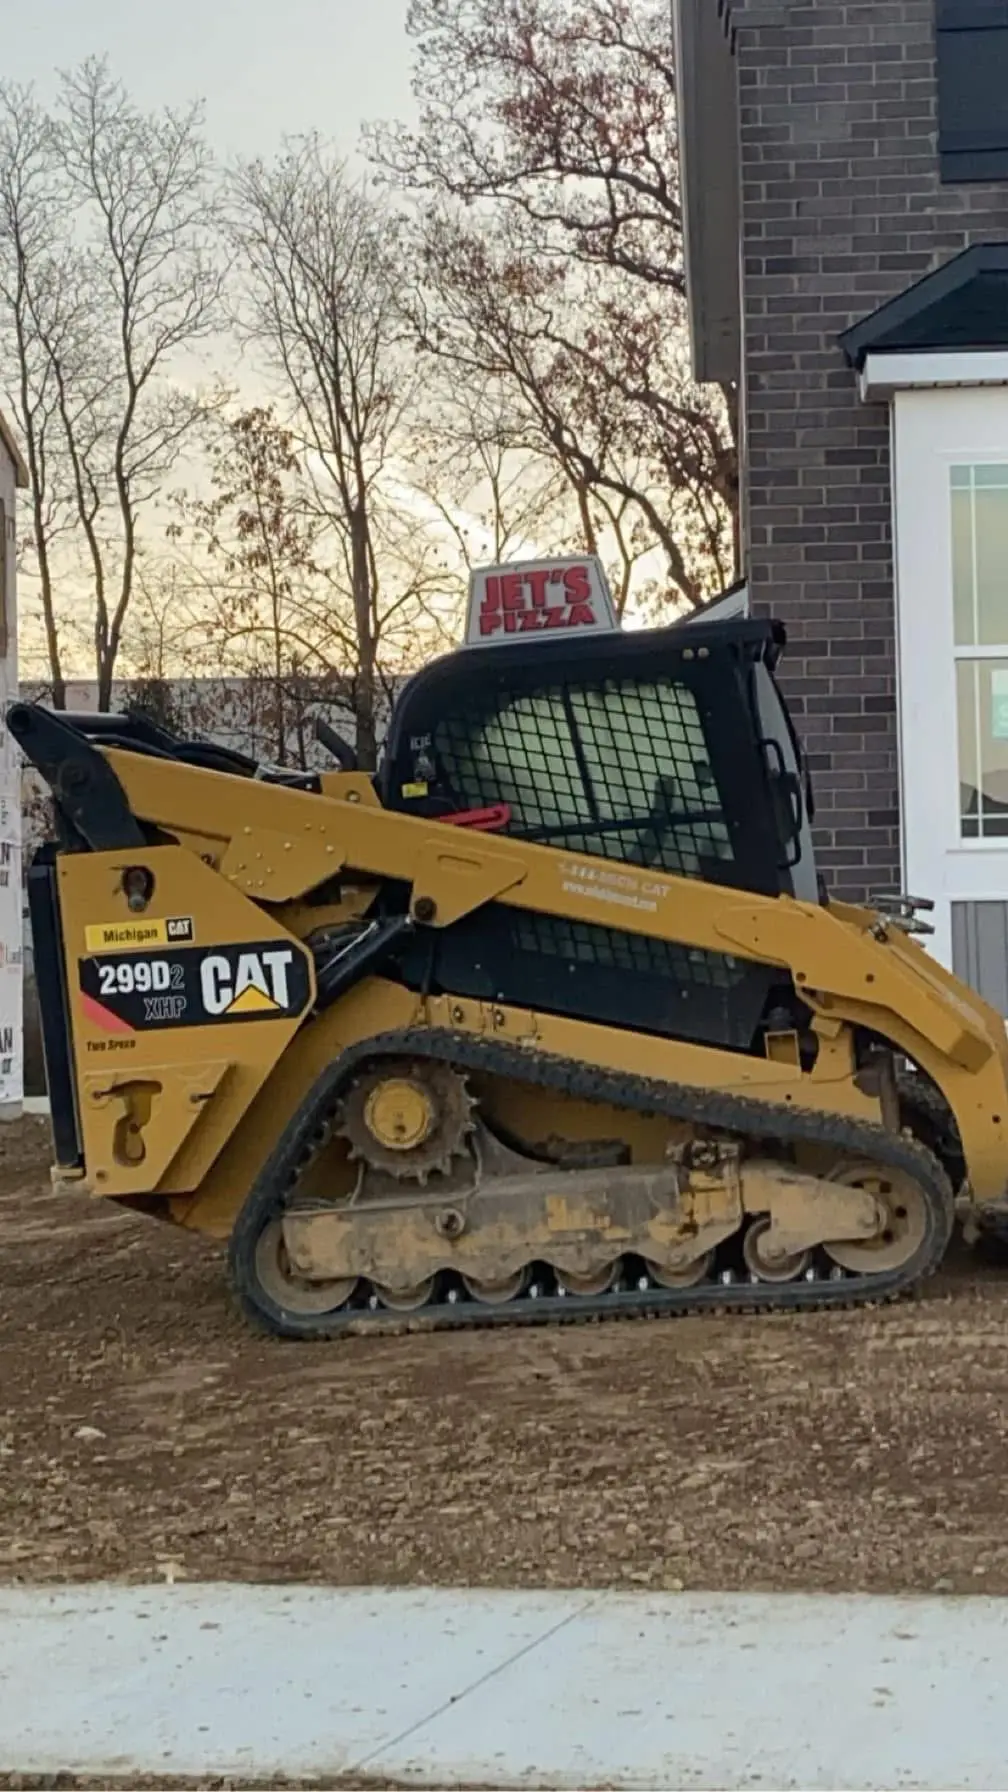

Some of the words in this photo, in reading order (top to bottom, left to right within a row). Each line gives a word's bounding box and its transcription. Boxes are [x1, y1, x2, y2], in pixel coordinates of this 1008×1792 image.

[480, 566, 592, 613] JET'S
[479, 604, 596, 635] PIZZA
[103, 927, 158, 943] Michigan
[167, 919, 191, 937] CAT
[99, 960, 186, 995] 299D2
[200, 951, 293, 1015] CAT
[143, 996, 187, 1021] XHP
